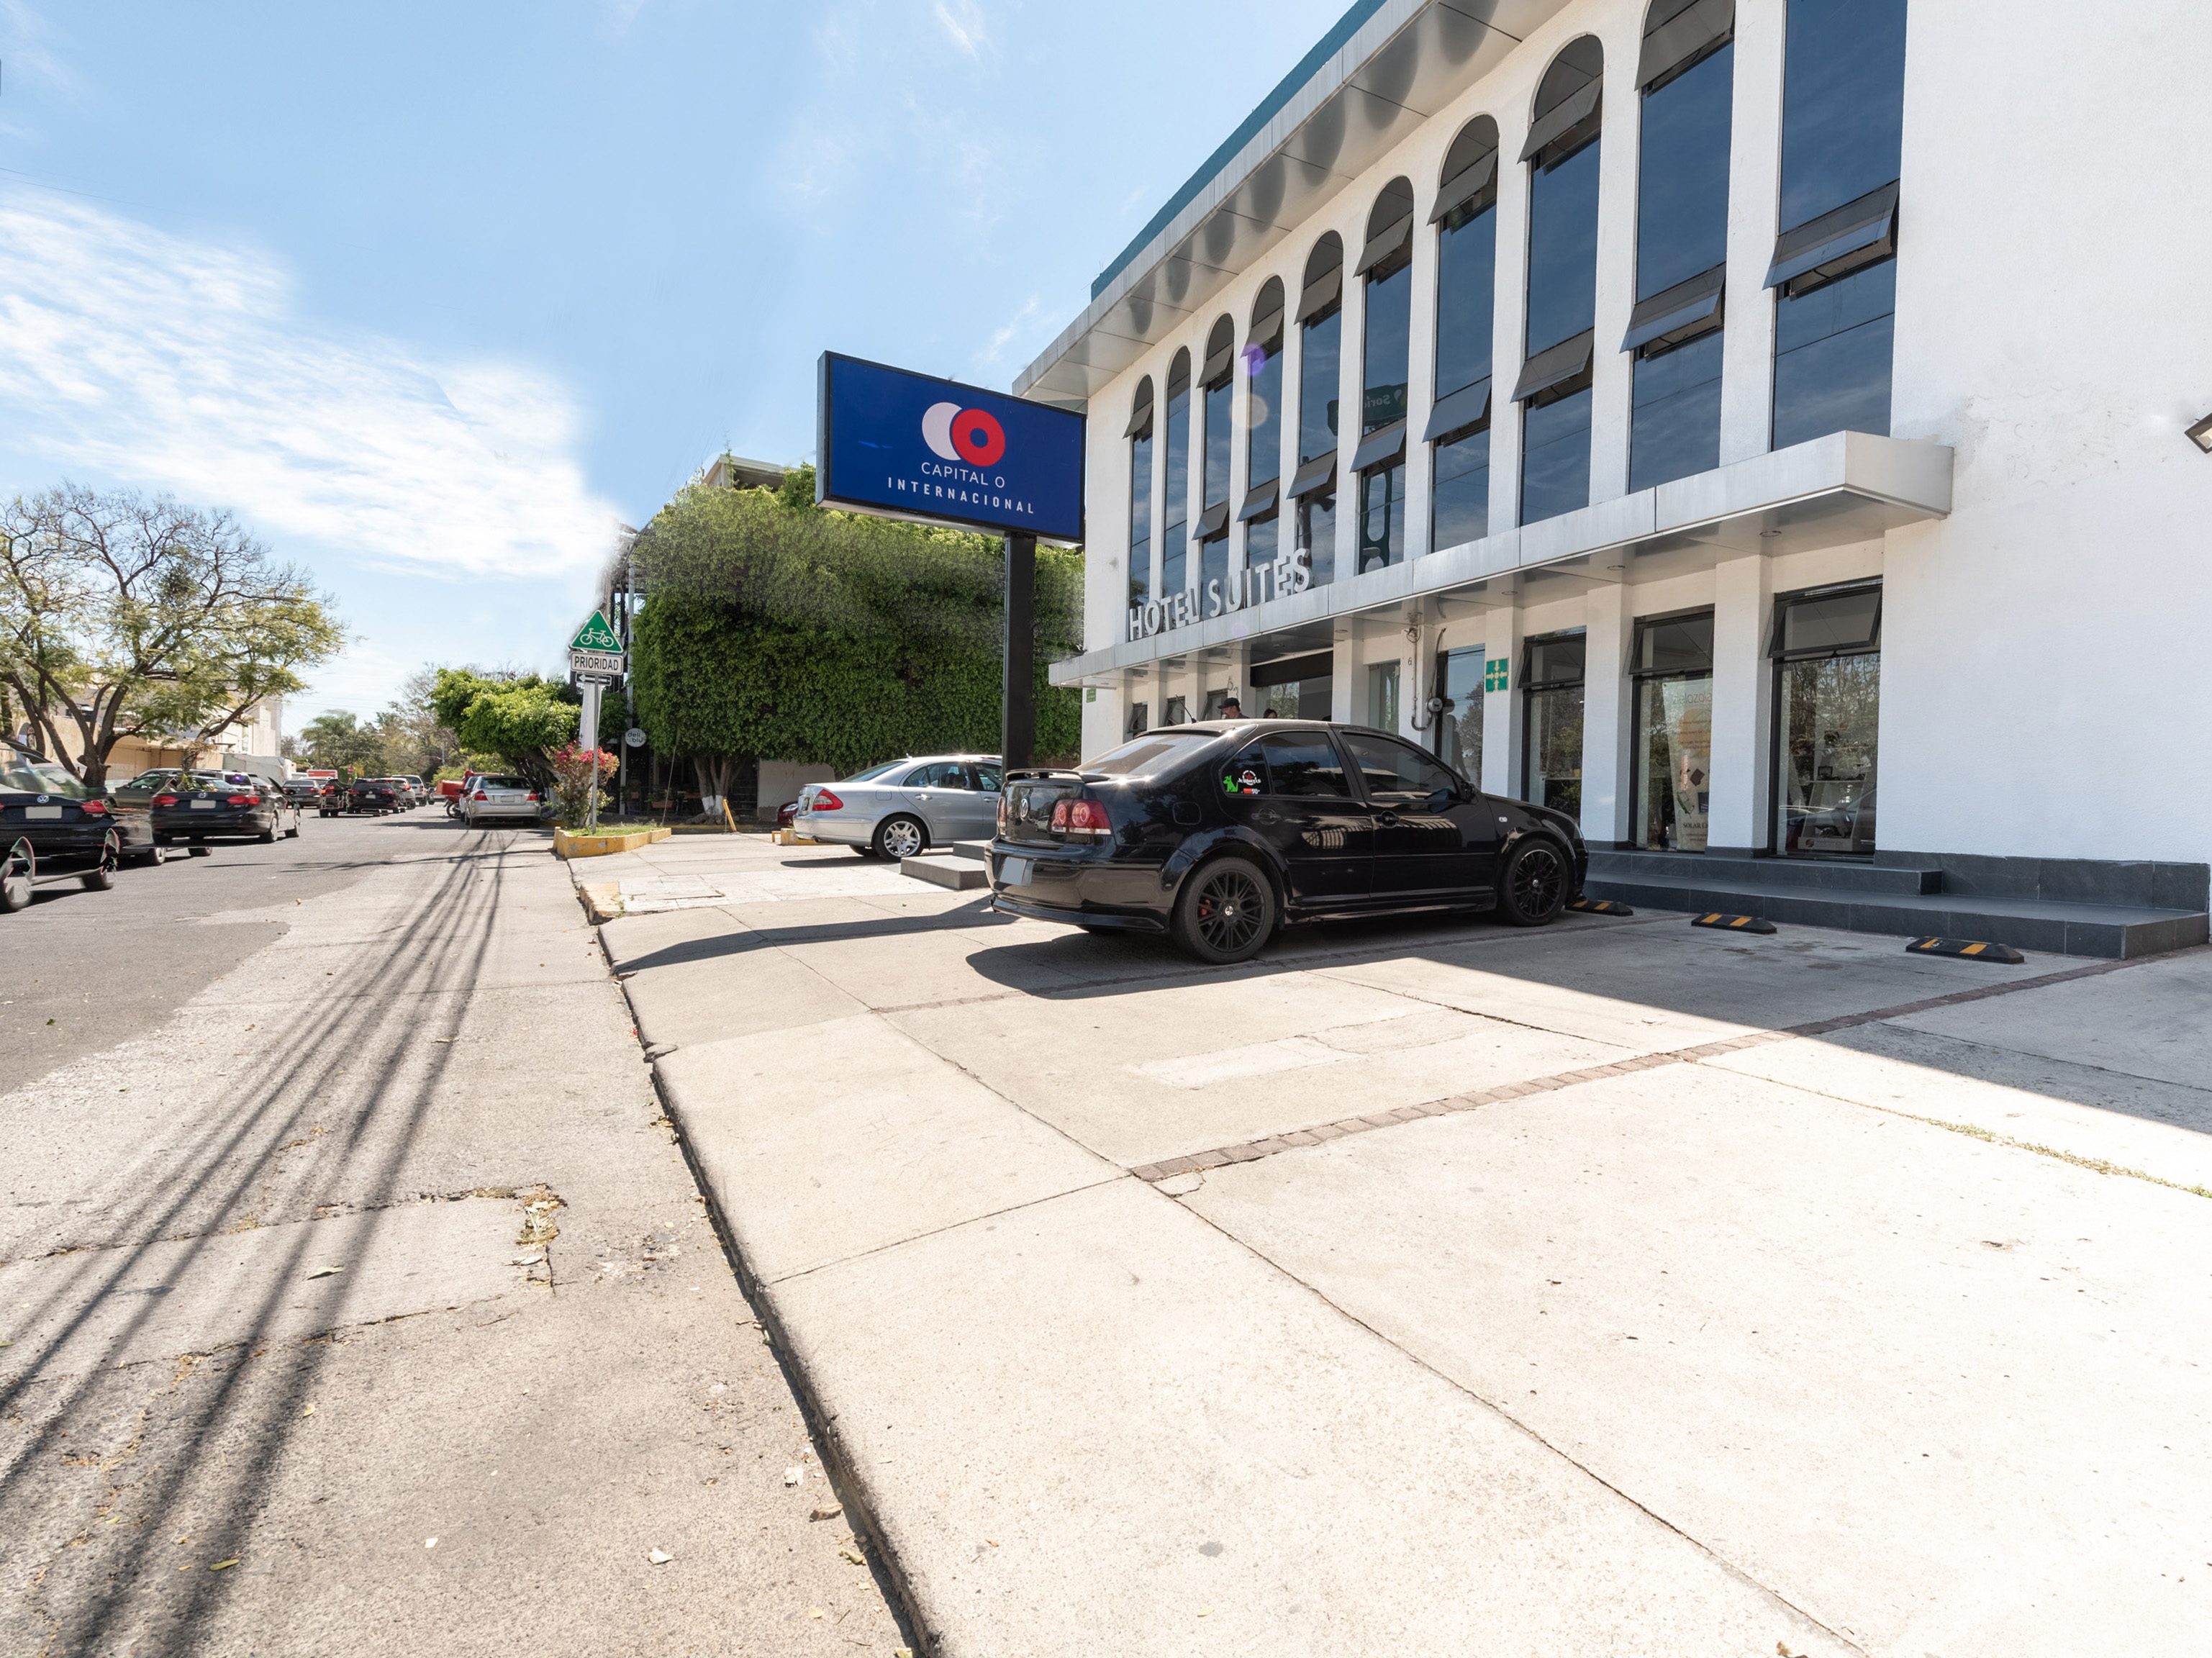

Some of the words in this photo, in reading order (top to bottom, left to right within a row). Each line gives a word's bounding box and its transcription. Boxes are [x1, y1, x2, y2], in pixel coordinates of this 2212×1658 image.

[921, 461, 988, 486] CAPITAL
[995, 476, 1005, 489] O
[888, 476, 1034, 514] INTERNACIONAL
[1129, 588, 1202, 641] HOTEL
[1207, 547, 1314, 617] SUITES
[574, 656, 619, 671] PRIORIDAD
